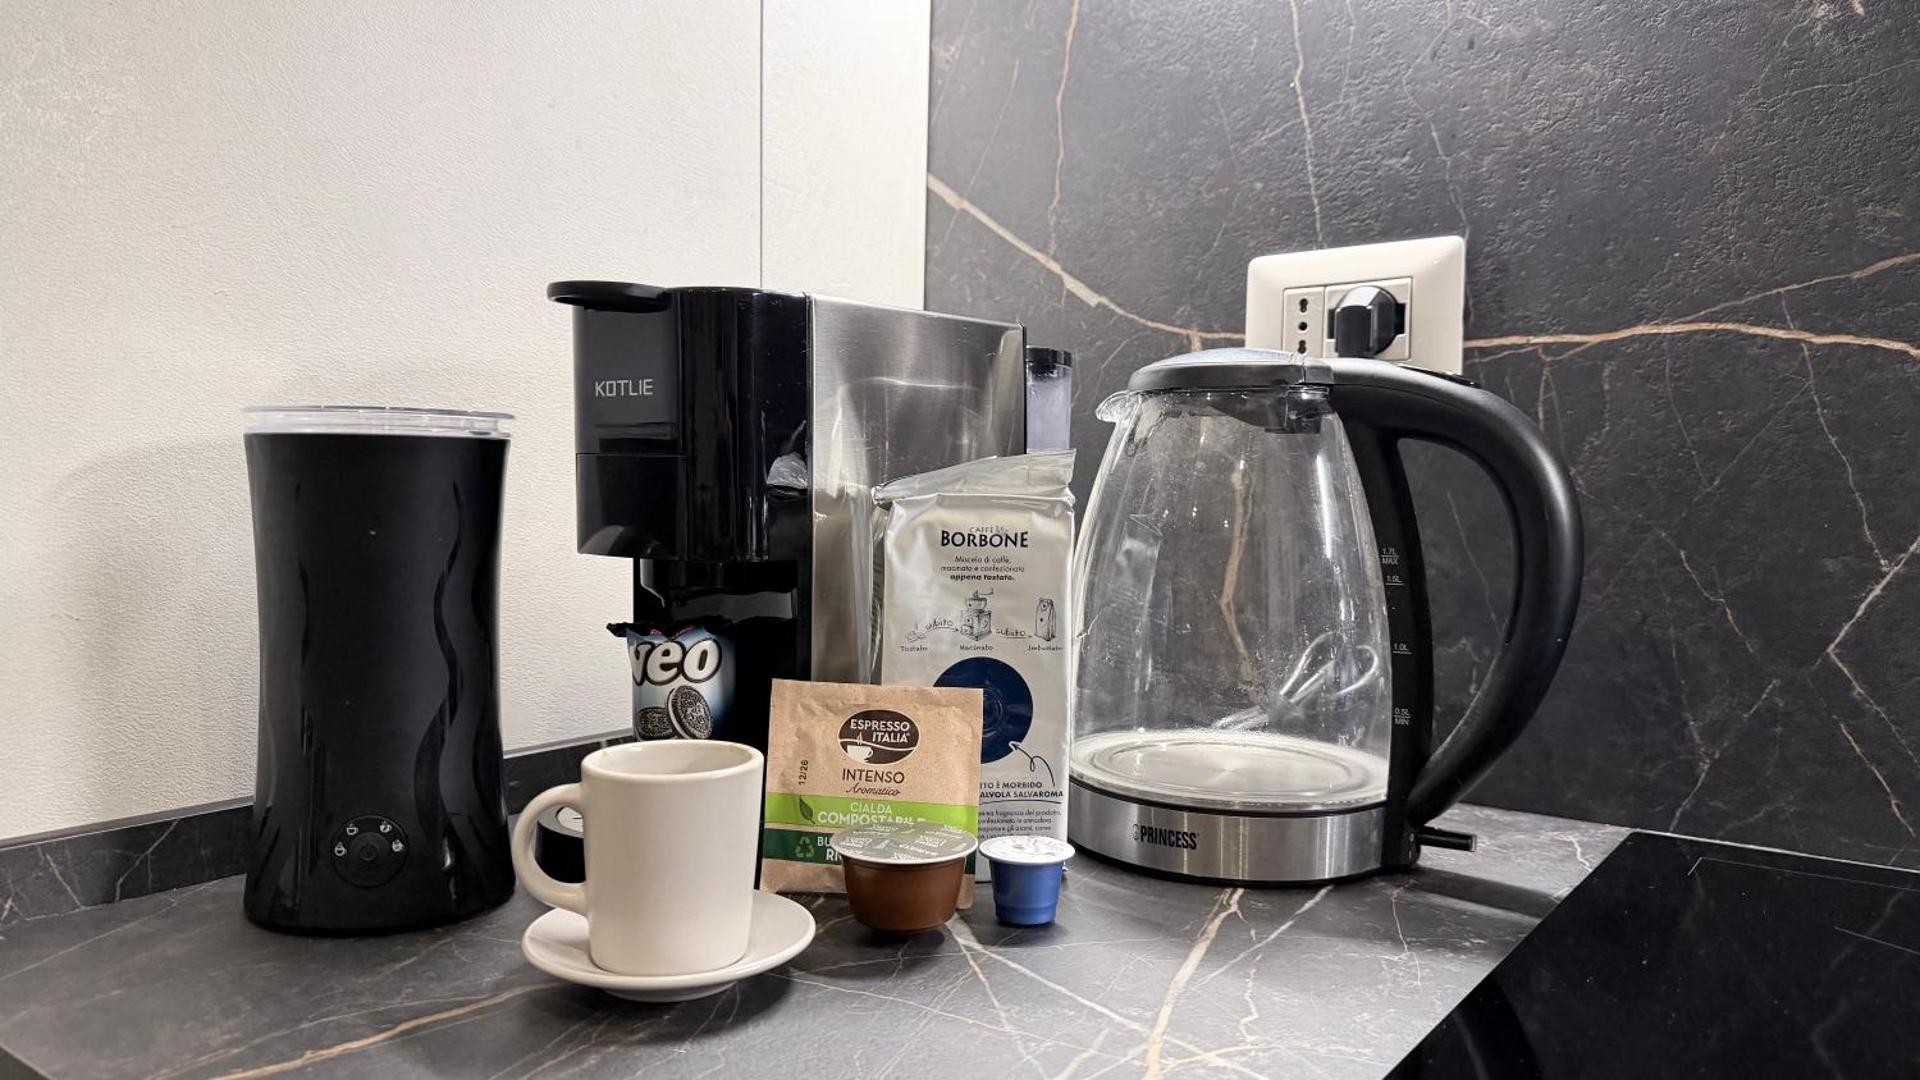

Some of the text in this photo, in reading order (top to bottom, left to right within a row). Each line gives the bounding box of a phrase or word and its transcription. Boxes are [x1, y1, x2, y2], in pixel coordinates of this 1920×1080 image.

[595, 379, 653, 397] KOTLIE
[941, 531, 1028, 548] BORBONE
[850, 718, 911, 732] ESPRESSO
[798, 760, 809, 786] 12/26
[842, 768, 905, 784] INTENSO
[845, 782, 901, 797] Aromatico
[1001, 781, 1043, 789] MORBIDO
[979, 790, 1064, 798] ALVOLA SALVAROMA
[850, 802, 893, 814] CIALDA
[1140, 825, 1197, 850] PRINCESS
